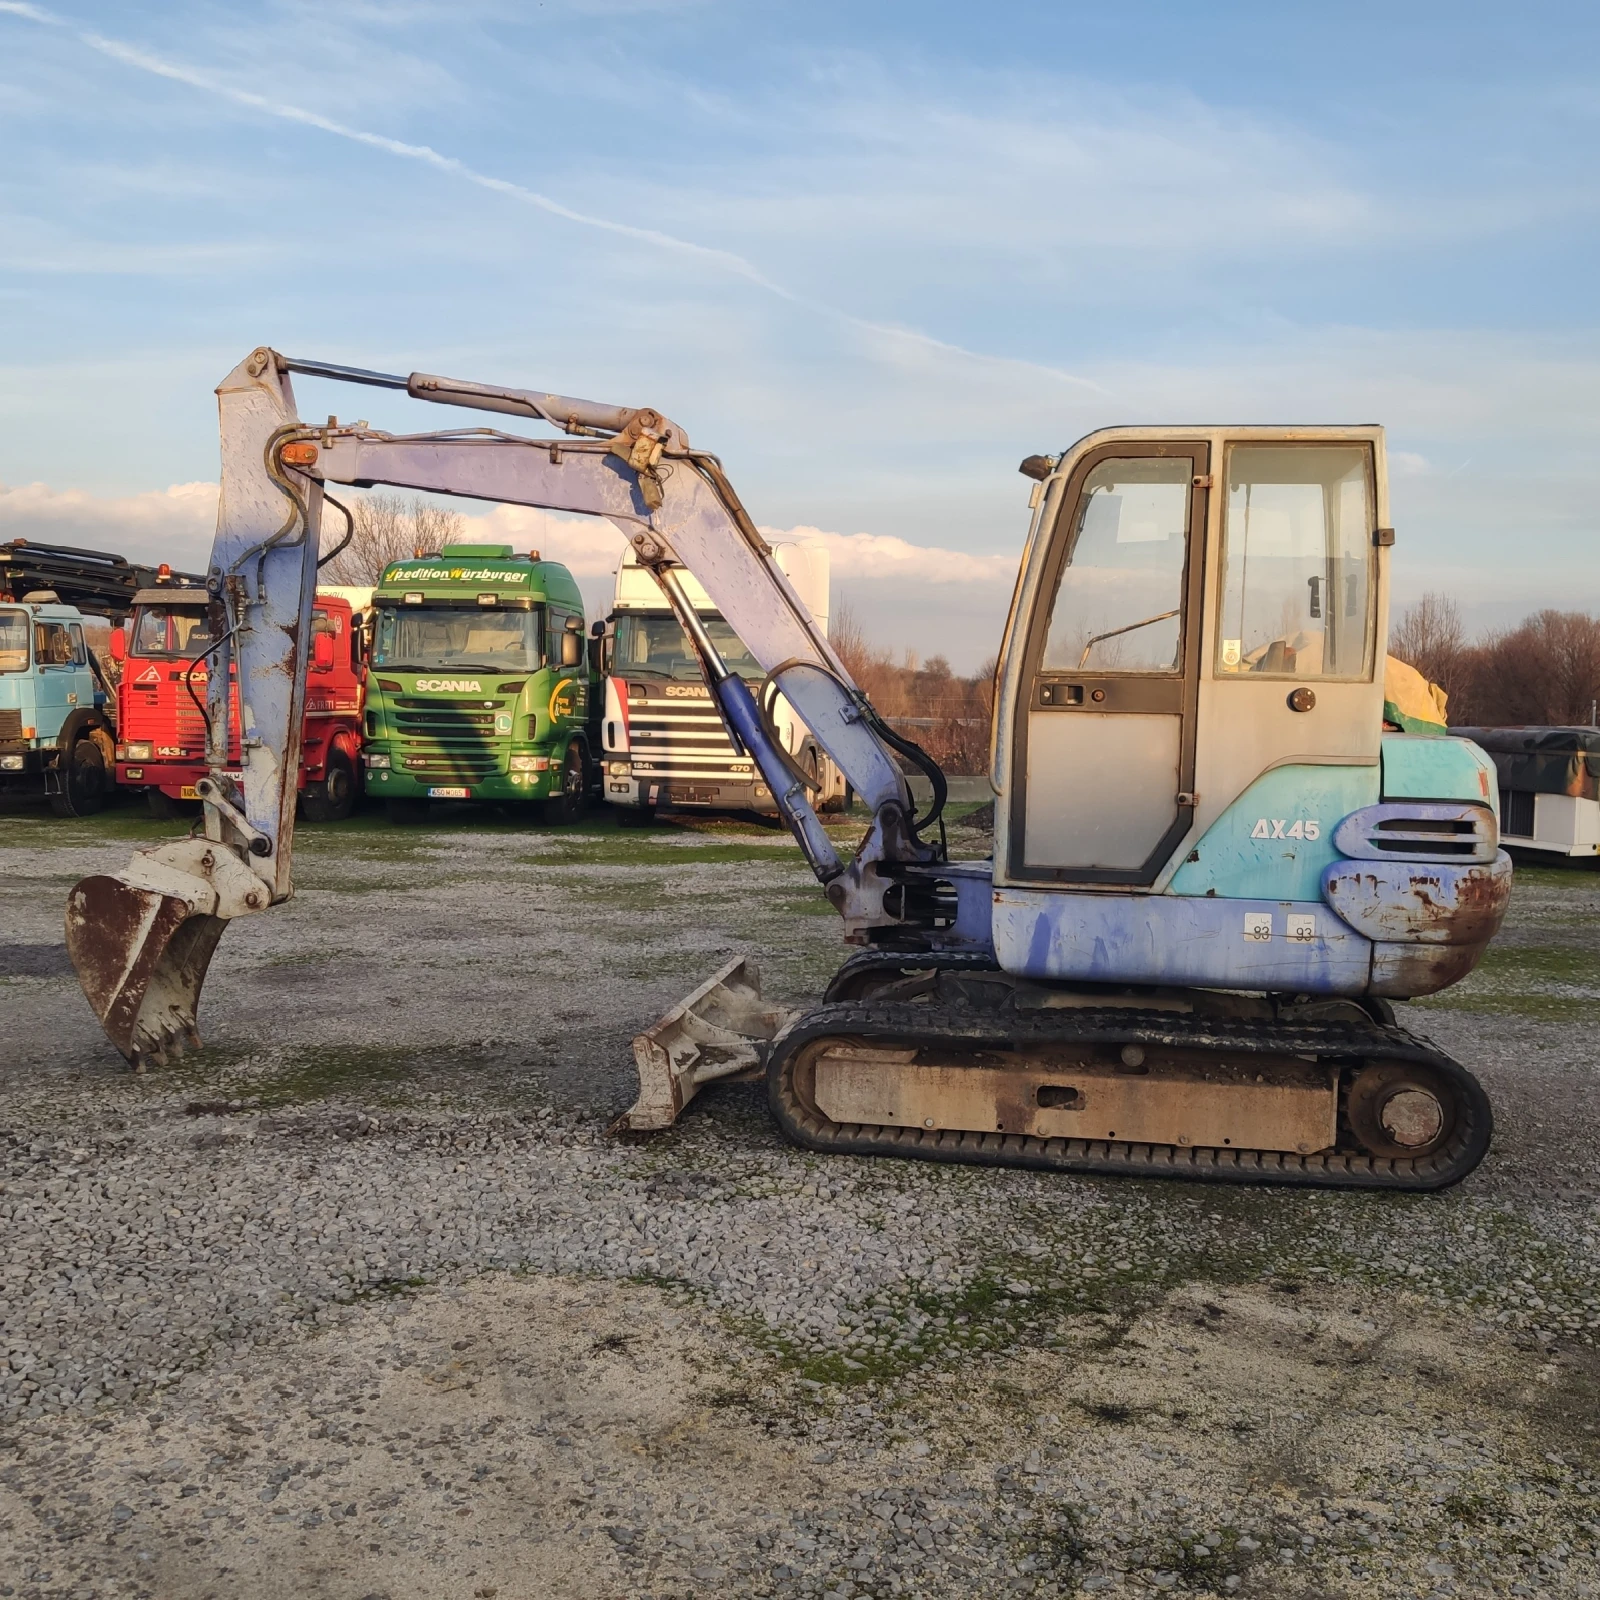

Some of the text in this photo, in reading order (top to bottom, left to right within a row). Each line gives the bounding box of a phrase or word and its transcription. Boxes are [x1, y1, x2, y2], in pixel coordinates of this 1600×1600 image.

[416, 679, 482, 692] SCANIA
[500, 718, 508, 730] L
[1250, 819, 1320, 841] AX45
[1296, 927, 1312, 942] 93
